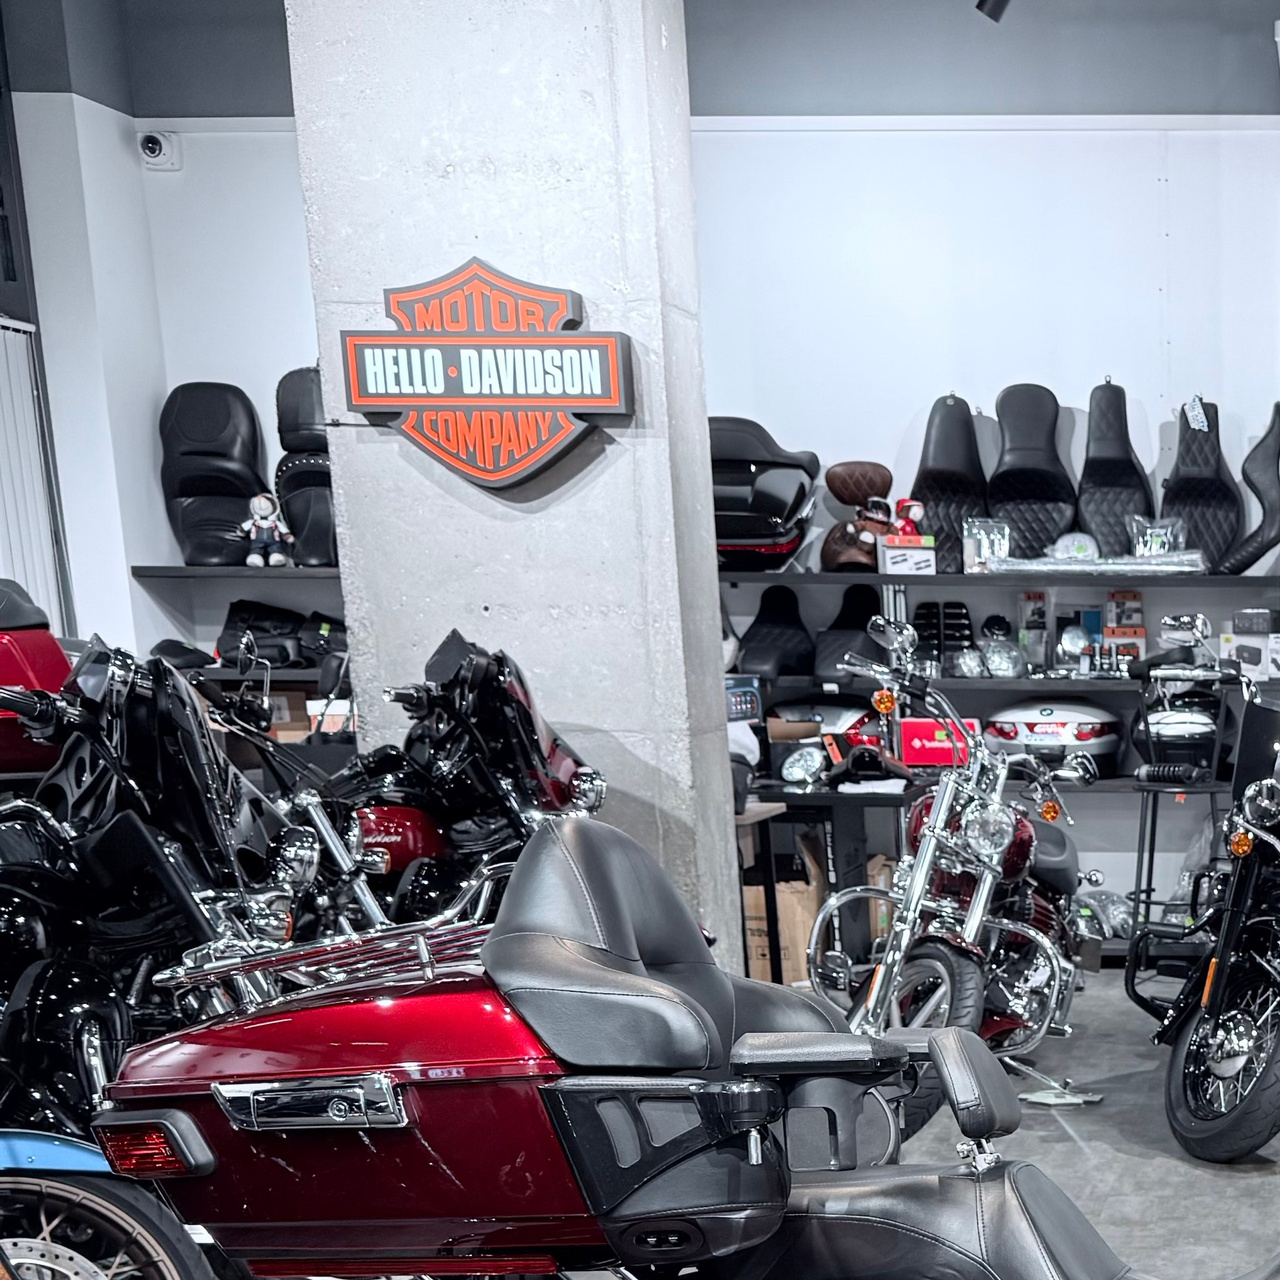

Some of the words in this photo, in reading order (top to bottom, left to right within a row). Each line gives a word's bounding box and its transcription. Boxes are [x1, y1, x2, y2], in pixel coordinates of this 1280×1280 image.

[414, 278, 545, 332] MOTOR
[363, 348, 445, 394] HELLO
[459, 348, 602, 395] DAVIDSON
[422, 410, 553, 469] COMPANY
